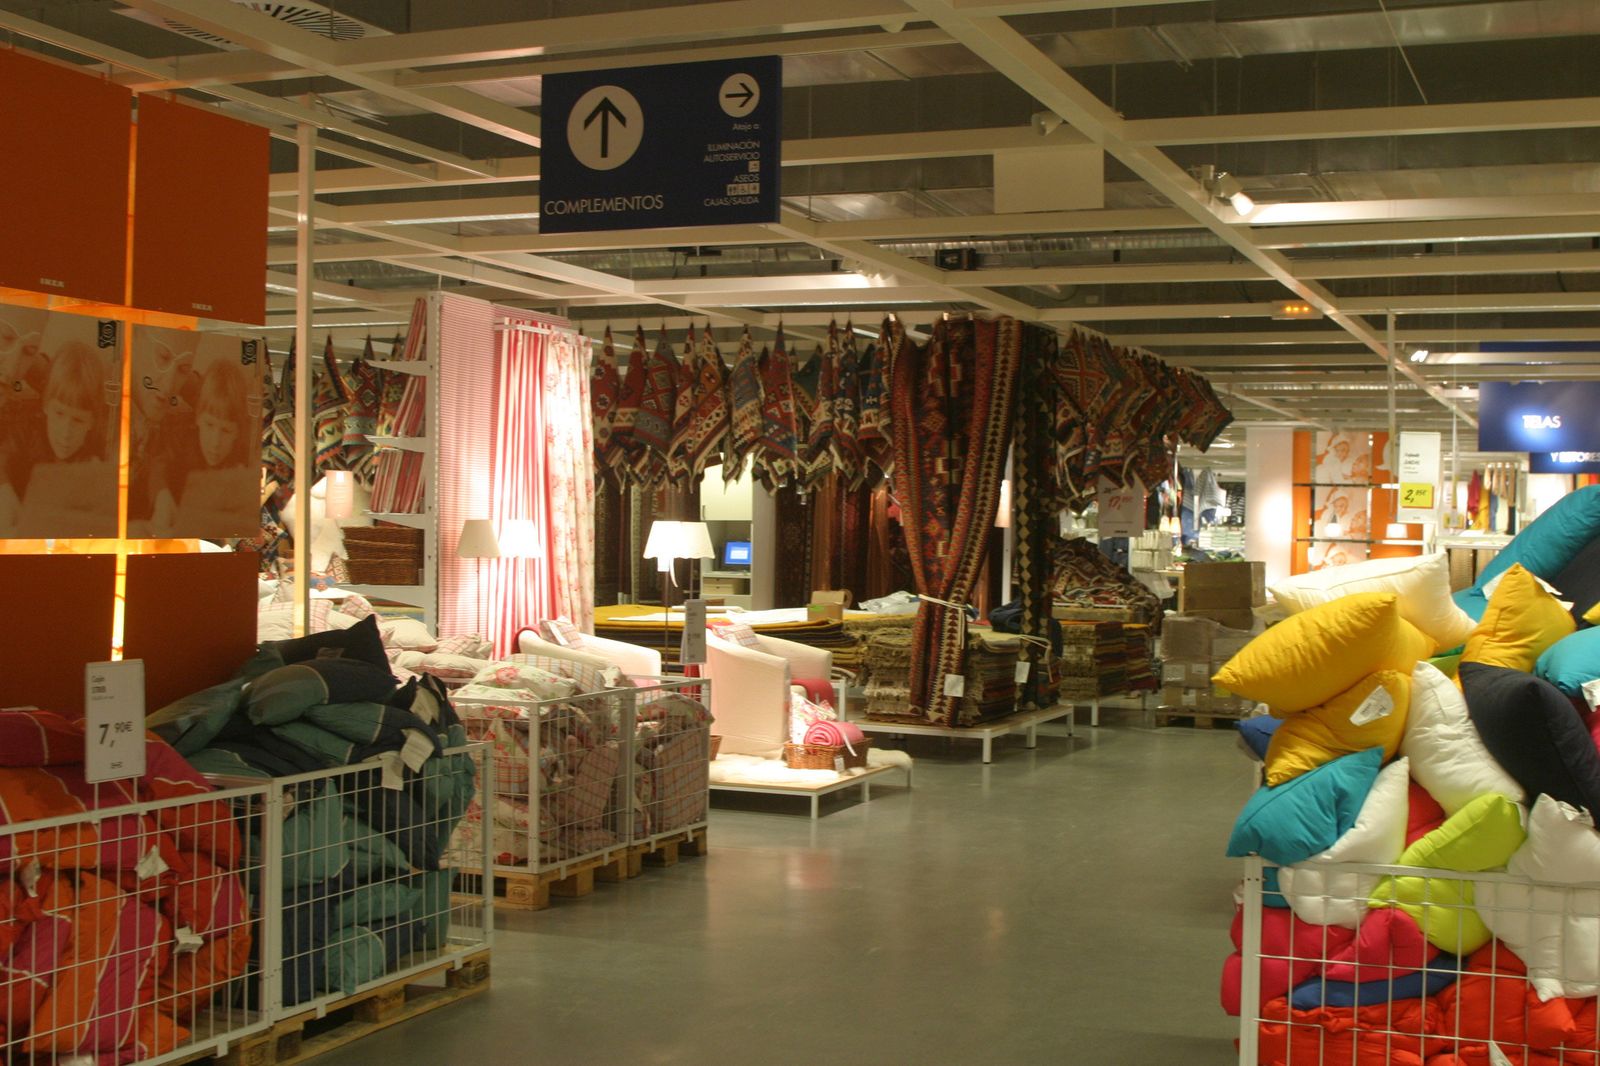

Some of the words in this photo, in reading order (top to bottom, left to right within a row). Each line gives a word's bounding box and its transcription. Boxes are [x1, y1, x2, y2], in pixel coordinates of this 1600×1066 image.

[703, 152, 760, 163] AUTOSERVICIO
[733, 173, 760, 183] ASEOS
[544, 194, 664, 215] COMPLEMENTOS
[40, 277, 65, 288] IKEA
[1521, 414, 1562, 429] TELAS
